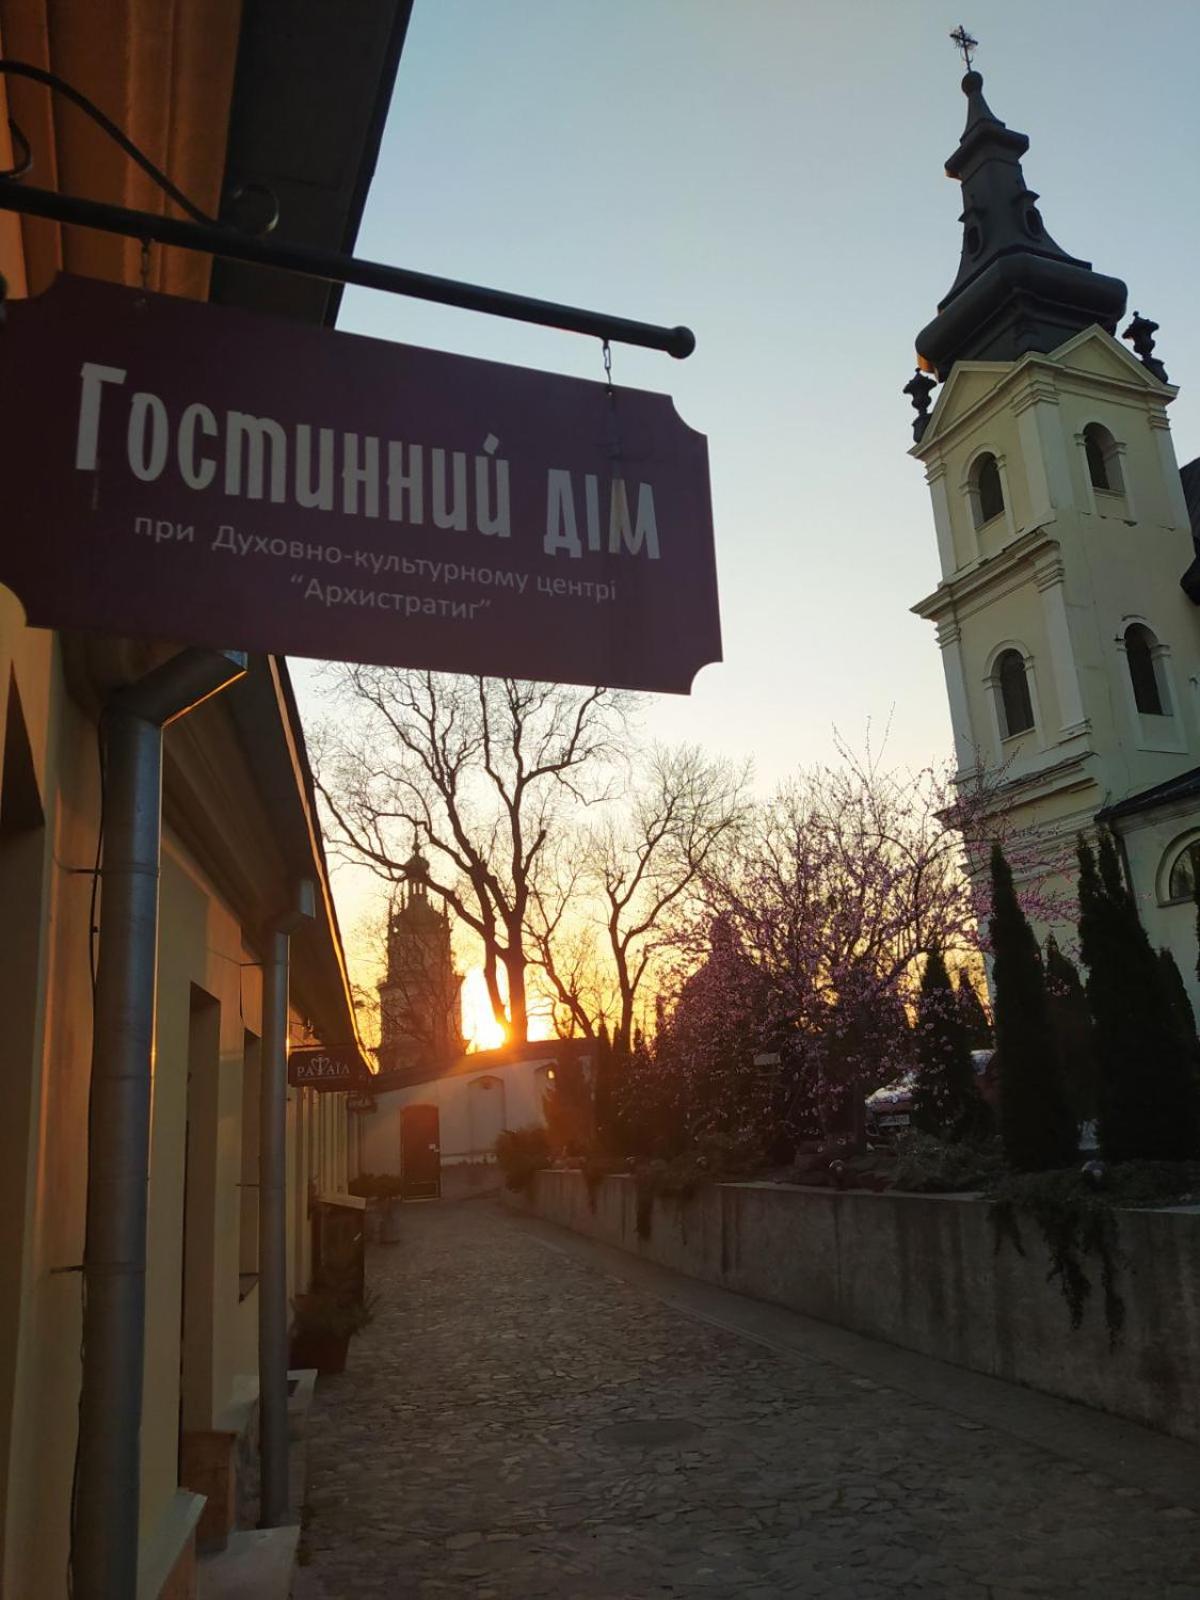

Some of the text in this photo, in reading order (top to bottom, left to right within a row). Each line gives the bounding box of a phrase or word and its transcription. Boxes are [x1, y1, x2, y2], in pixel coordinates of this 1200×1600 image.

[75, 361, 511, 538] Гостинний
[133, 516, 617, 603] при Духовно-культурному центрі
